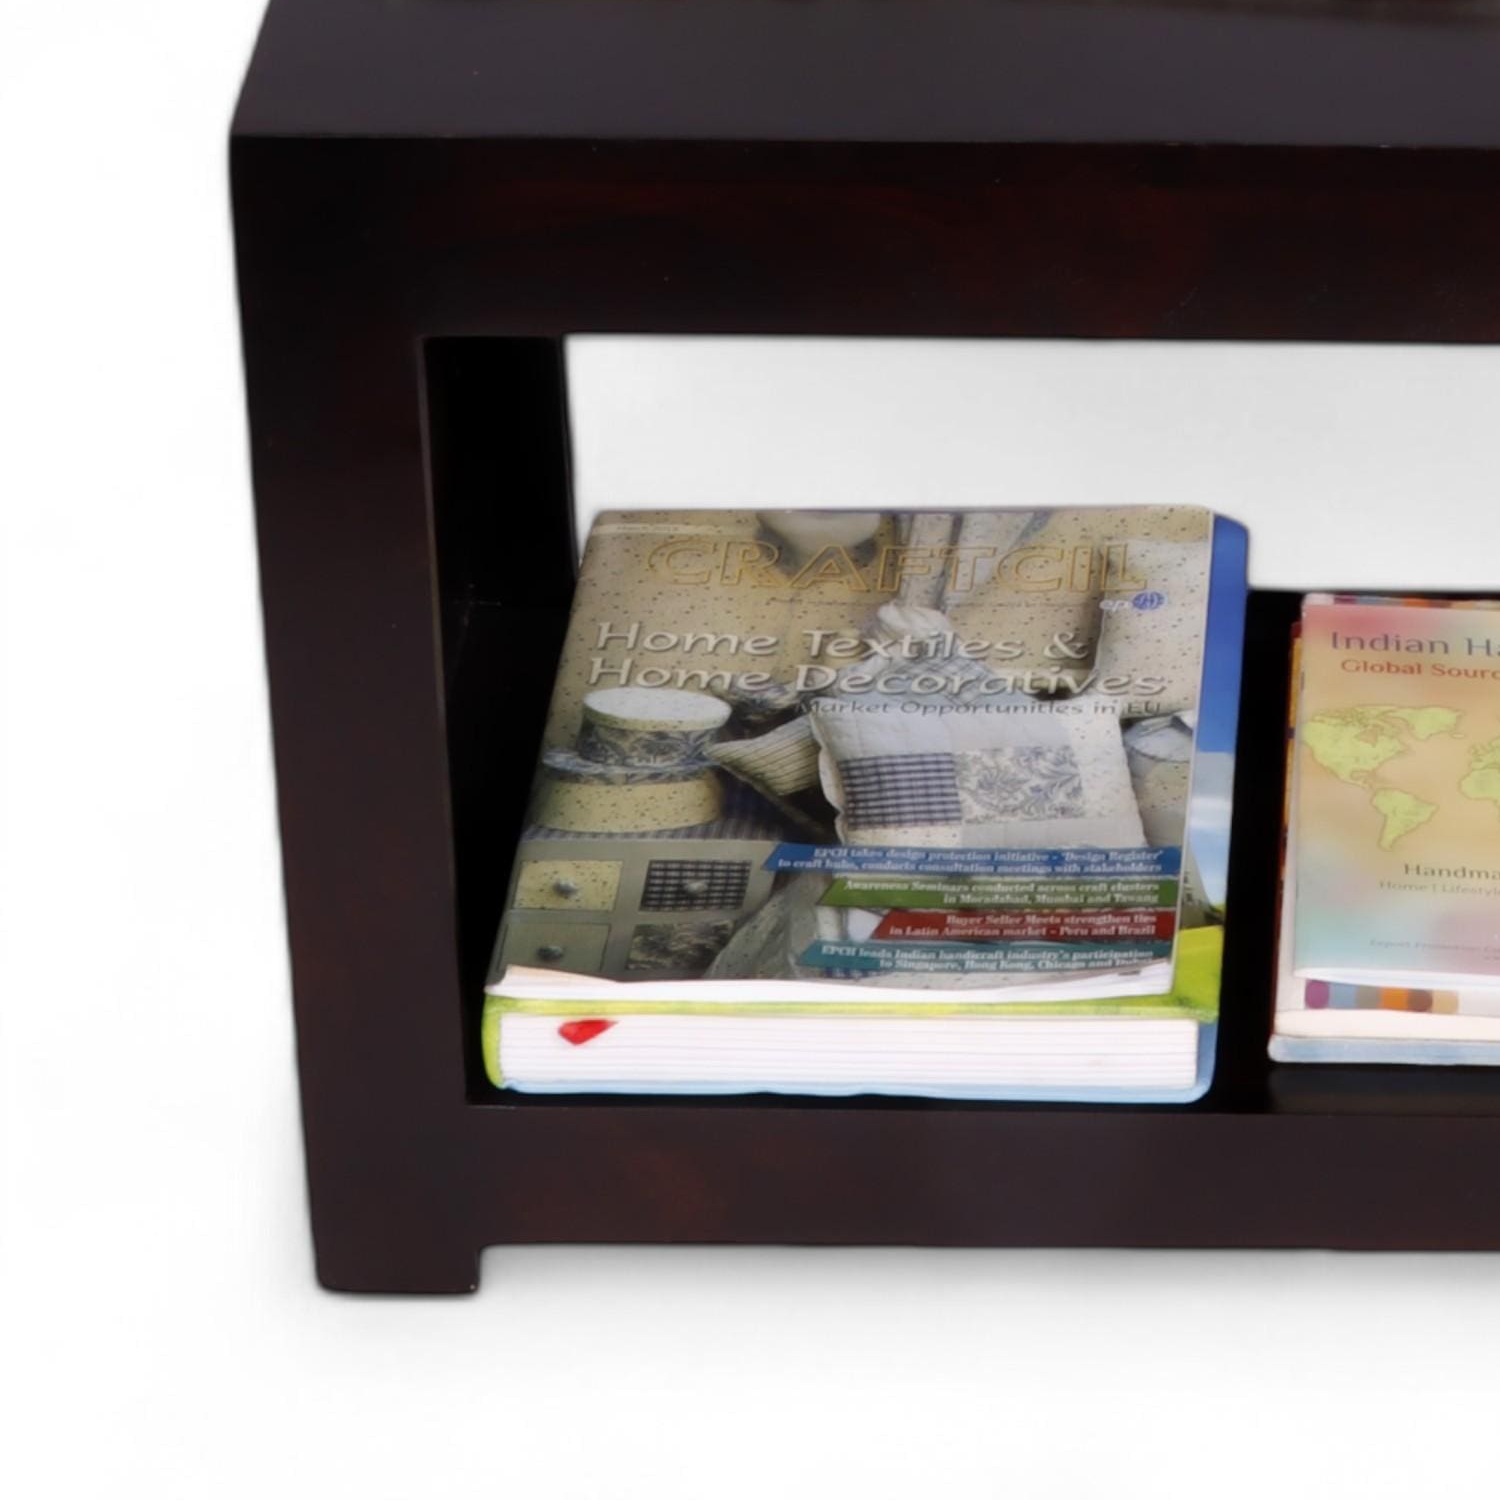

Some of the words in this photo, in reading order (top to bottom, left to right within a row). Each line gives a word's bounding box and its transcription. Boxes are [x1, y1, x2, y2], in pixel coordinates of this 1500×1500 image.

[648, 538, 1148, 593] CRAFTCIL
[598, 621, 780, 656] Home
[802, 629, 1026, 661] Textiles
[1043, 631, 1090, 660] &
[1331, 630, 1451, 656] Indian
[1340, 657, 1424, 676] Global
[588, 657, 773, 692] Home
[796, 663, 1168, 697] Decoratives
[801, 699, 890, 715] Market
[900, 700, 1084, 717] Opportunities
[1092, 701, 1118, 715] in
[1126, 702, 1161, 715] EU
[814, 848, 848, 858] EPCH
[851, 848, 883, 858] takes
[886, 849, 925, 861] design
[928, 850, 991, 862] protection
[994, 850, 1049, 861] initiative
[778, 859, 790, 868] to
[793, 859, 822, 869] craft
[862, 861, 916, 871] conducts
[919, 861, 994, 873] consultation
[997, 863, 1052, 875] meetings
[1055, 863, 1081, 874] with
[1084, 862, 1162, 874] stakeholders
[844, 880, 908, 892] Awareness
[911, 881, 969, 893] Seminars
[972, 882, 1034, 893] conducted
[1037, 884, 1076, 893] across
[1079, 882, 1108, 893] craft
[1110, 882, 1160, 893] clusters
[1379, 879, 1431, 893] Home
[1036, 893, 1085, 904] Mumbai
[1087, 893, 1112, 904] and
[946, 915, 982, 927] Buyer
[985, 915, 1021, 925] Seller
[1025, 914, 1061, 925] Meets
[1064, 914, 1131, 927] strengthen
[1133, 914, 1157, 924] ties
[889, 926, 903, 936] in
[906, 926, 939, 936] Latin
[942, 926, 1000, 937] American
[1002, 926, 1047, 937] market
[1060, 926, 1088, 936] Peru
[1091, 925, 1116, 936] and
[1118, 924, 1156, 936] Brazil
[822, 945, 857, 956] EPCH
[859, 946, 892, 958] leads
[894, 946, 936, 959] Indian
[939, 947, 1005, 960] handicraft
[1072, 948, 1153, 962] participation
[964, 960, 997, 972] Hong
